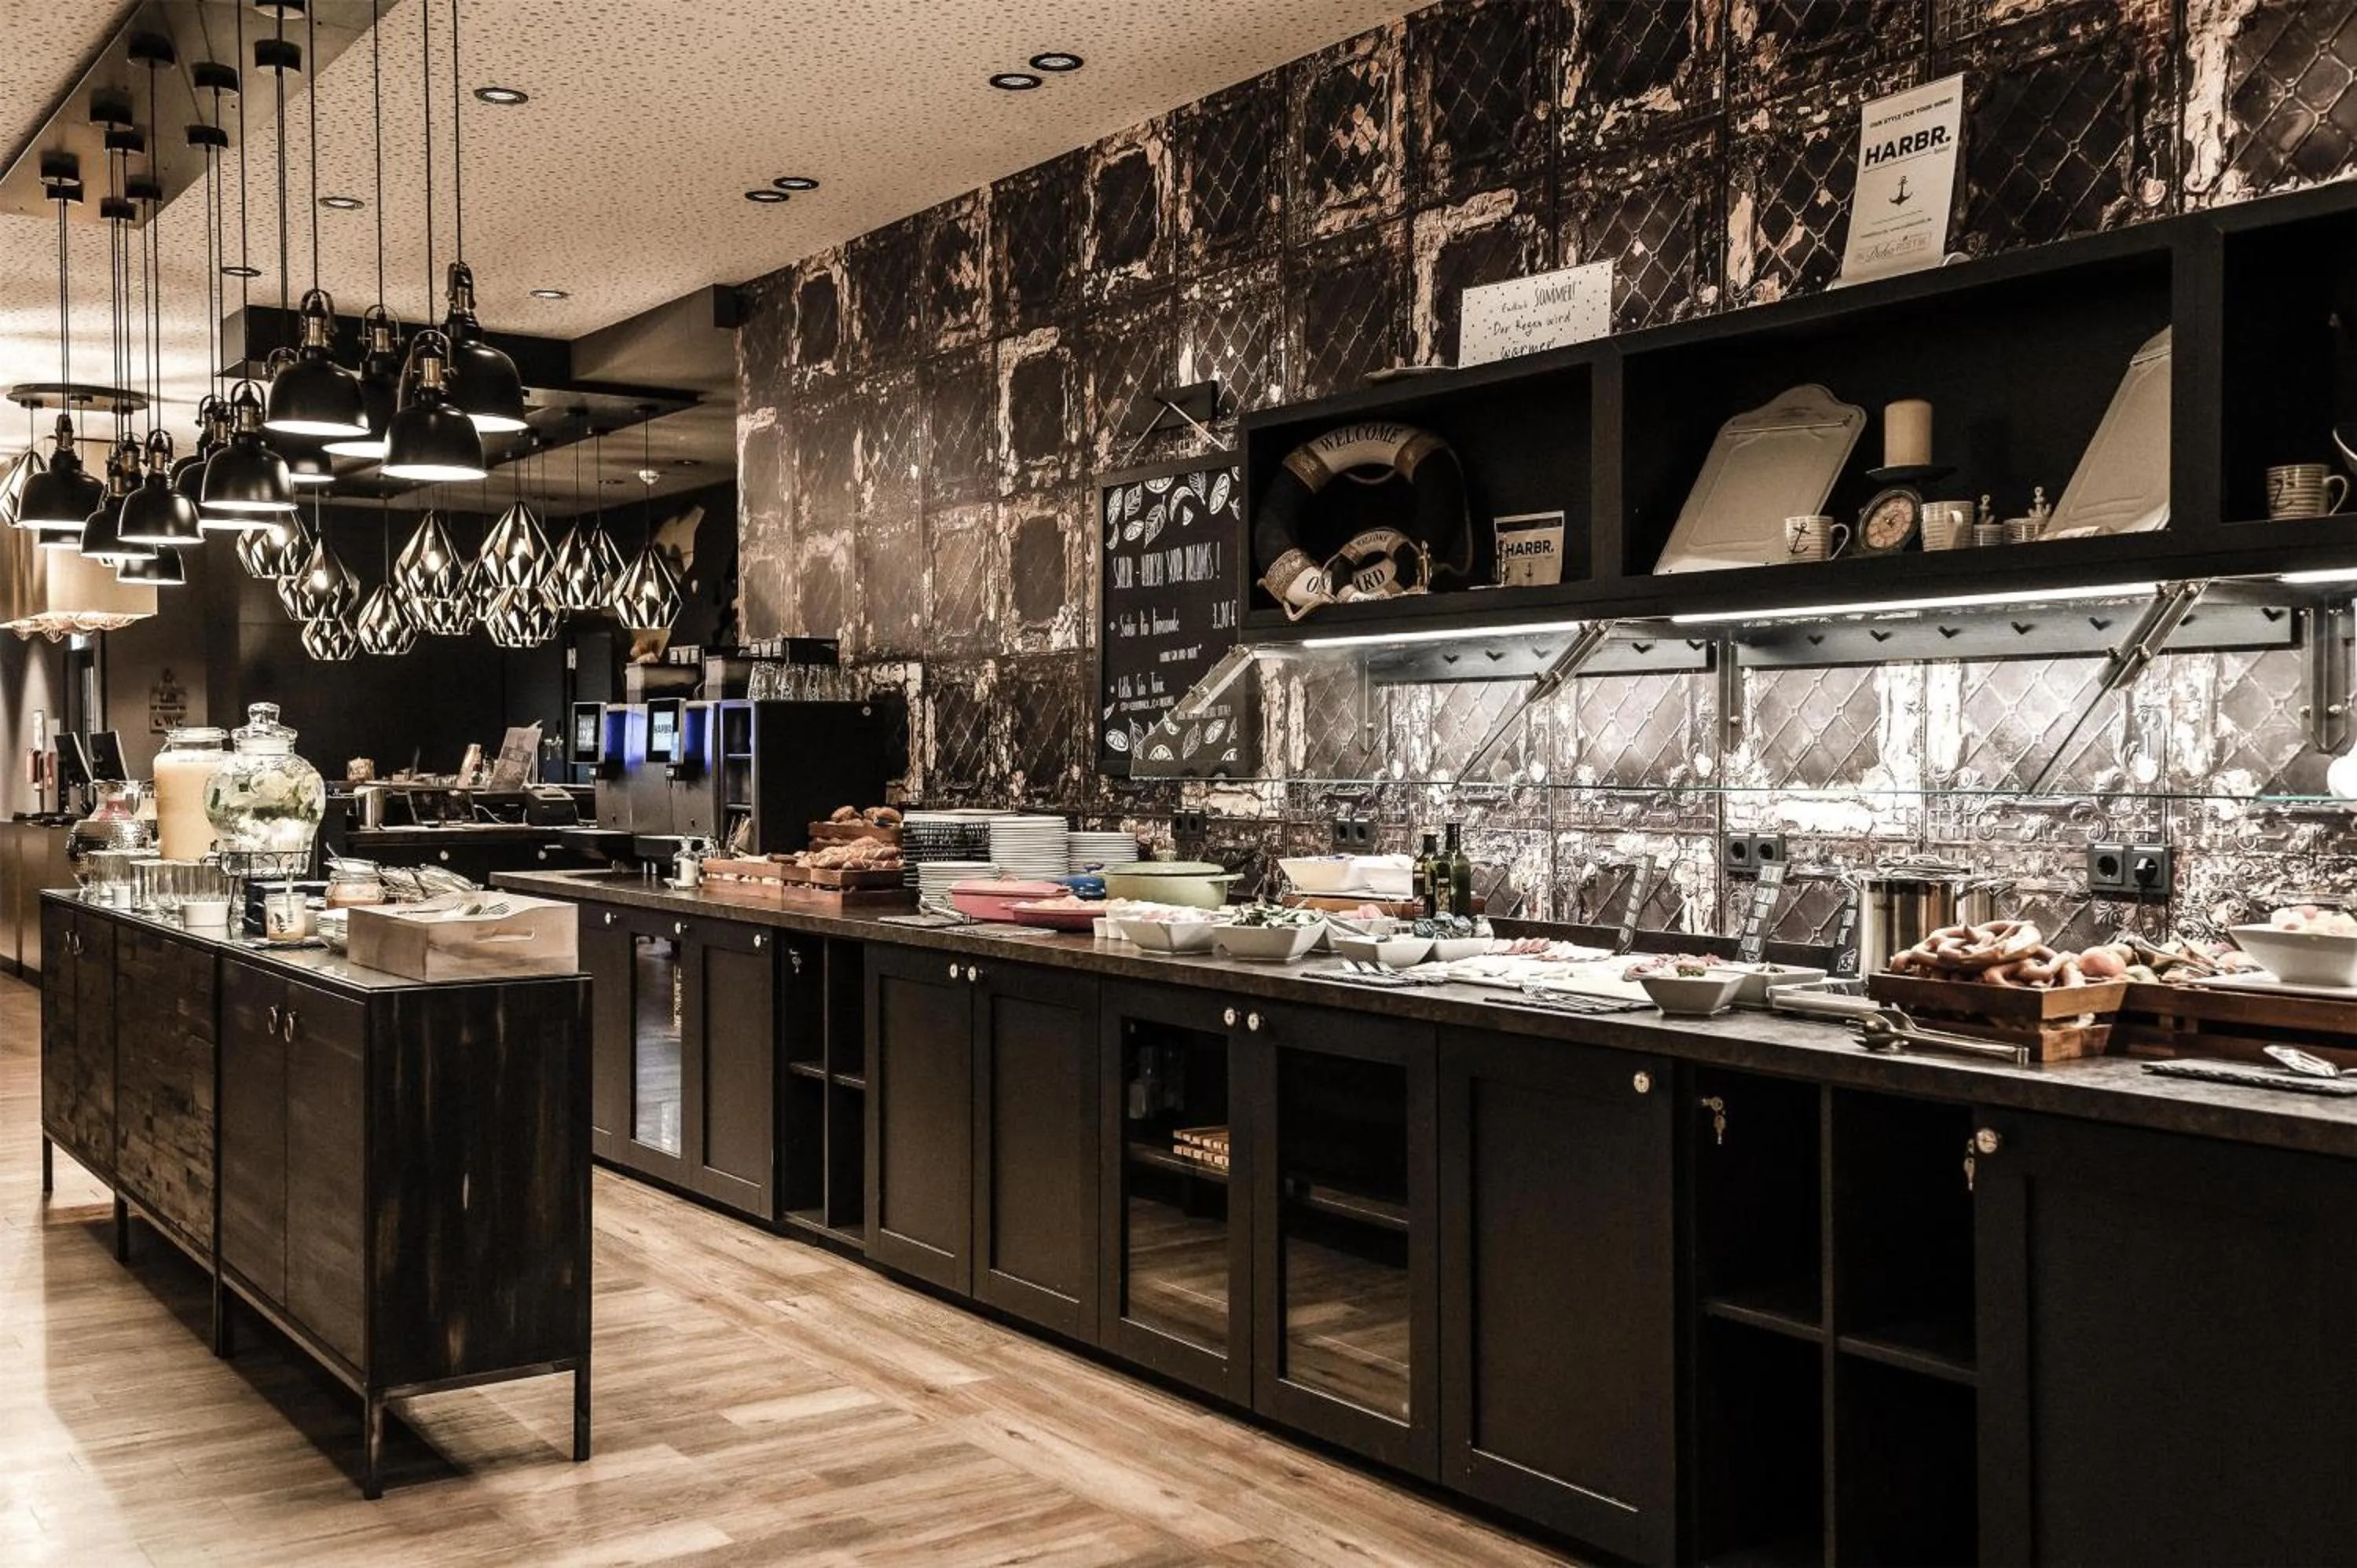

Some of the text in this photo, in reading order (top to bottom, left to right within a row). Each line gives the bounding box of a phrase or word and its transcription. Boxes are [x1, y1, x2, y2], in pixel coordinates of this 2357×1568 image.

[1864, 124, 1952, 167] HARBR.
[1494, 310, 1571, 337] Der Regen wird
[1320, 423, 1403, 452] WELCOME
[1506, 539, 1555, 558] HARBR.
[1353, 569, 1385, 592] ARD
